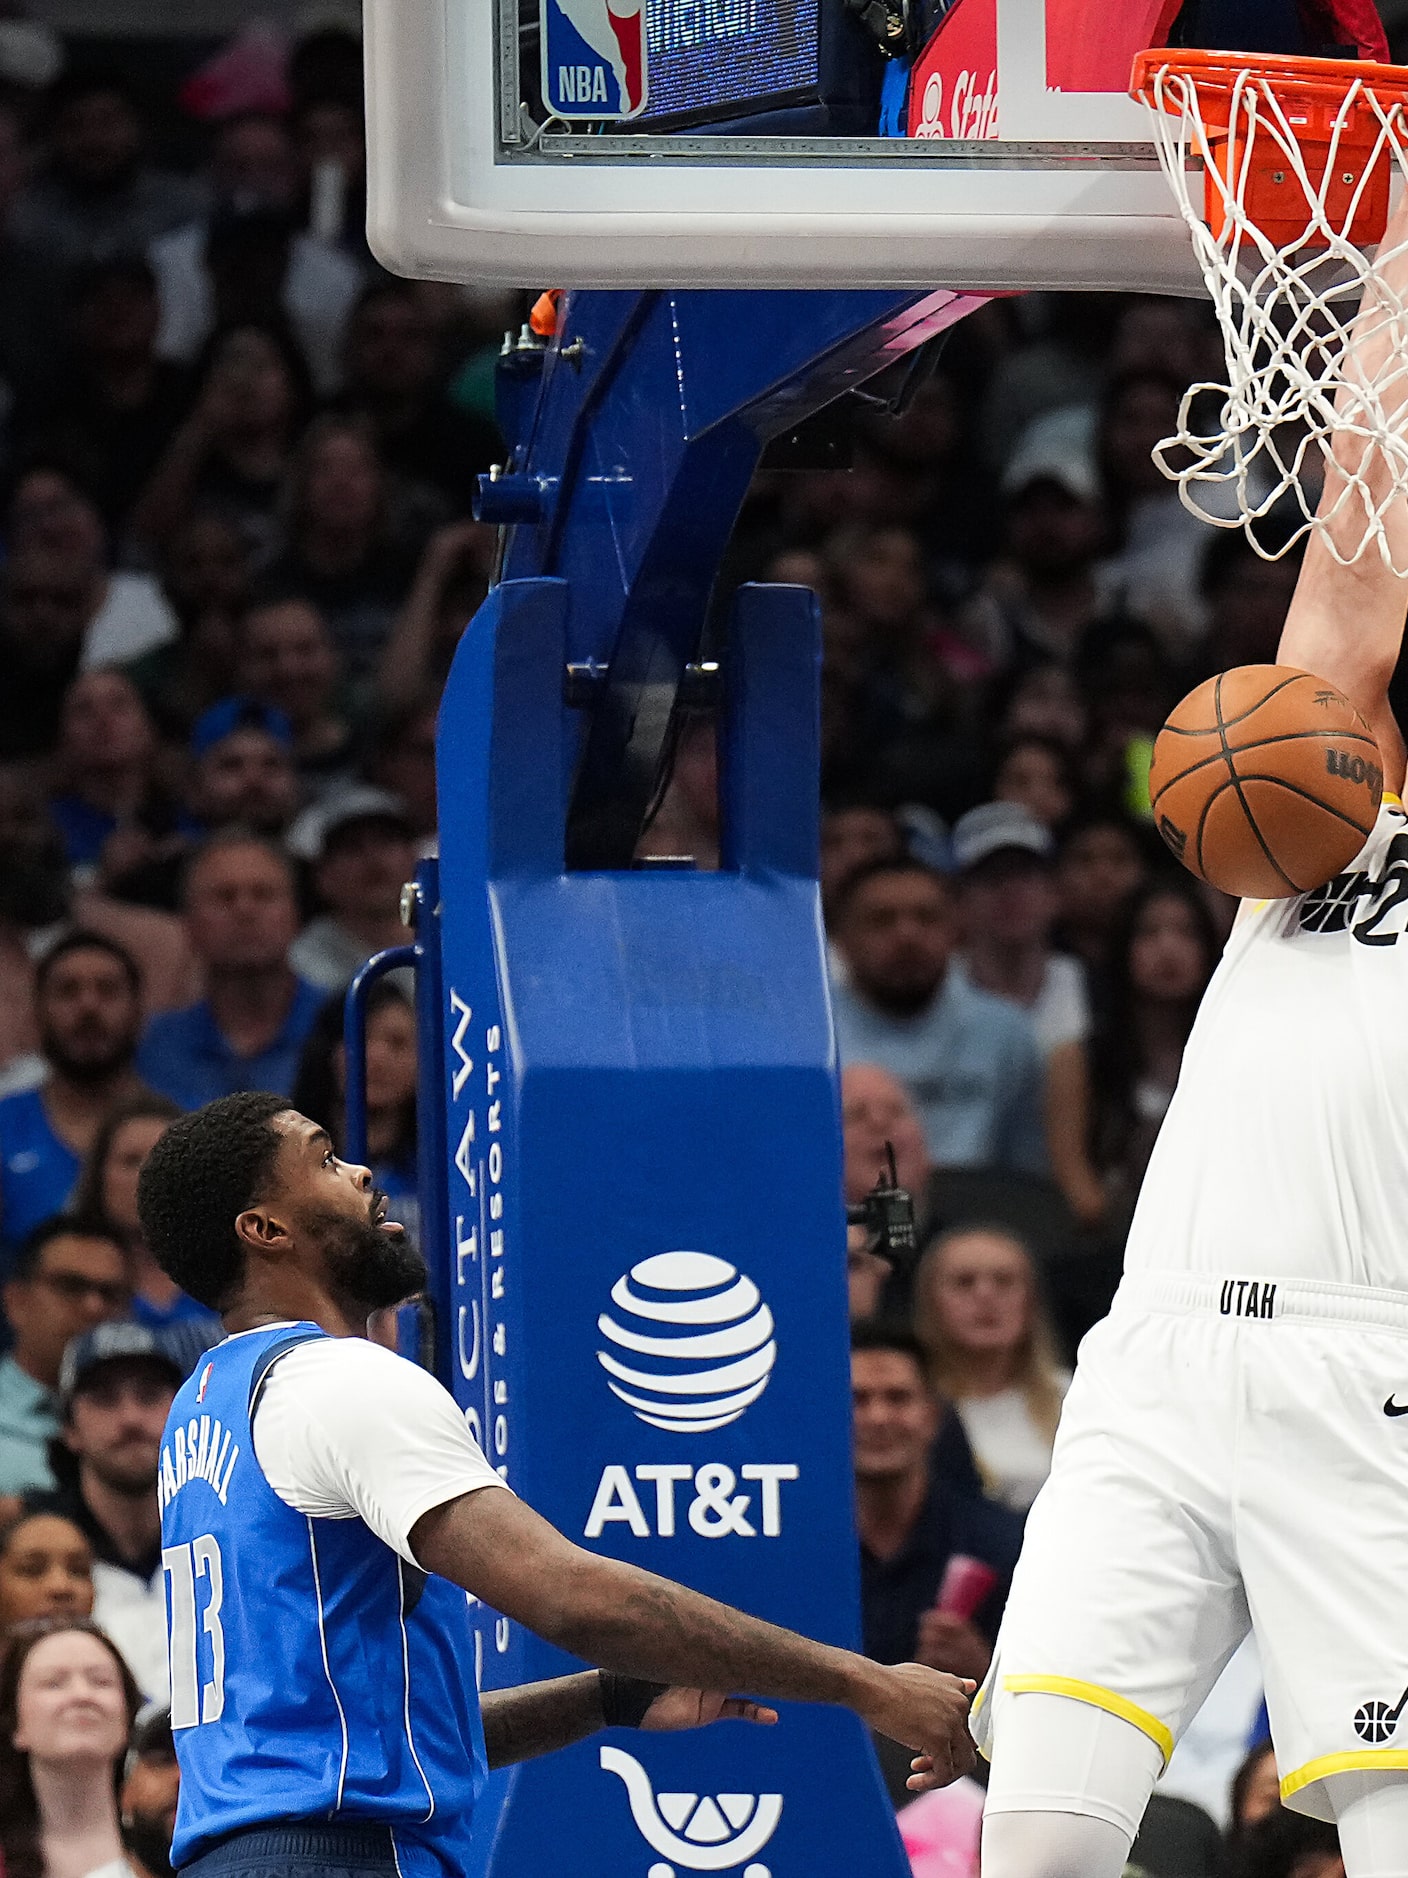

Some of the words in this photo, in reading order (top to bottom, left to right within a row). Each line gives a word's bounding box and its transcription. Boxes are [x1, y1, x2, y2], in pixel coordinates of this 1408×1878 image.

[559, 66, 607, 103] NBA
[486, 1025, 505, 1298] RESORTS
[1219, 1280, 1277, 1320] UTAH
[157, 1414, 240, 1522] ARSHALL
[584, 1463, 799, 1538] AT&T
[162, 1533, 226, 1731] 13
